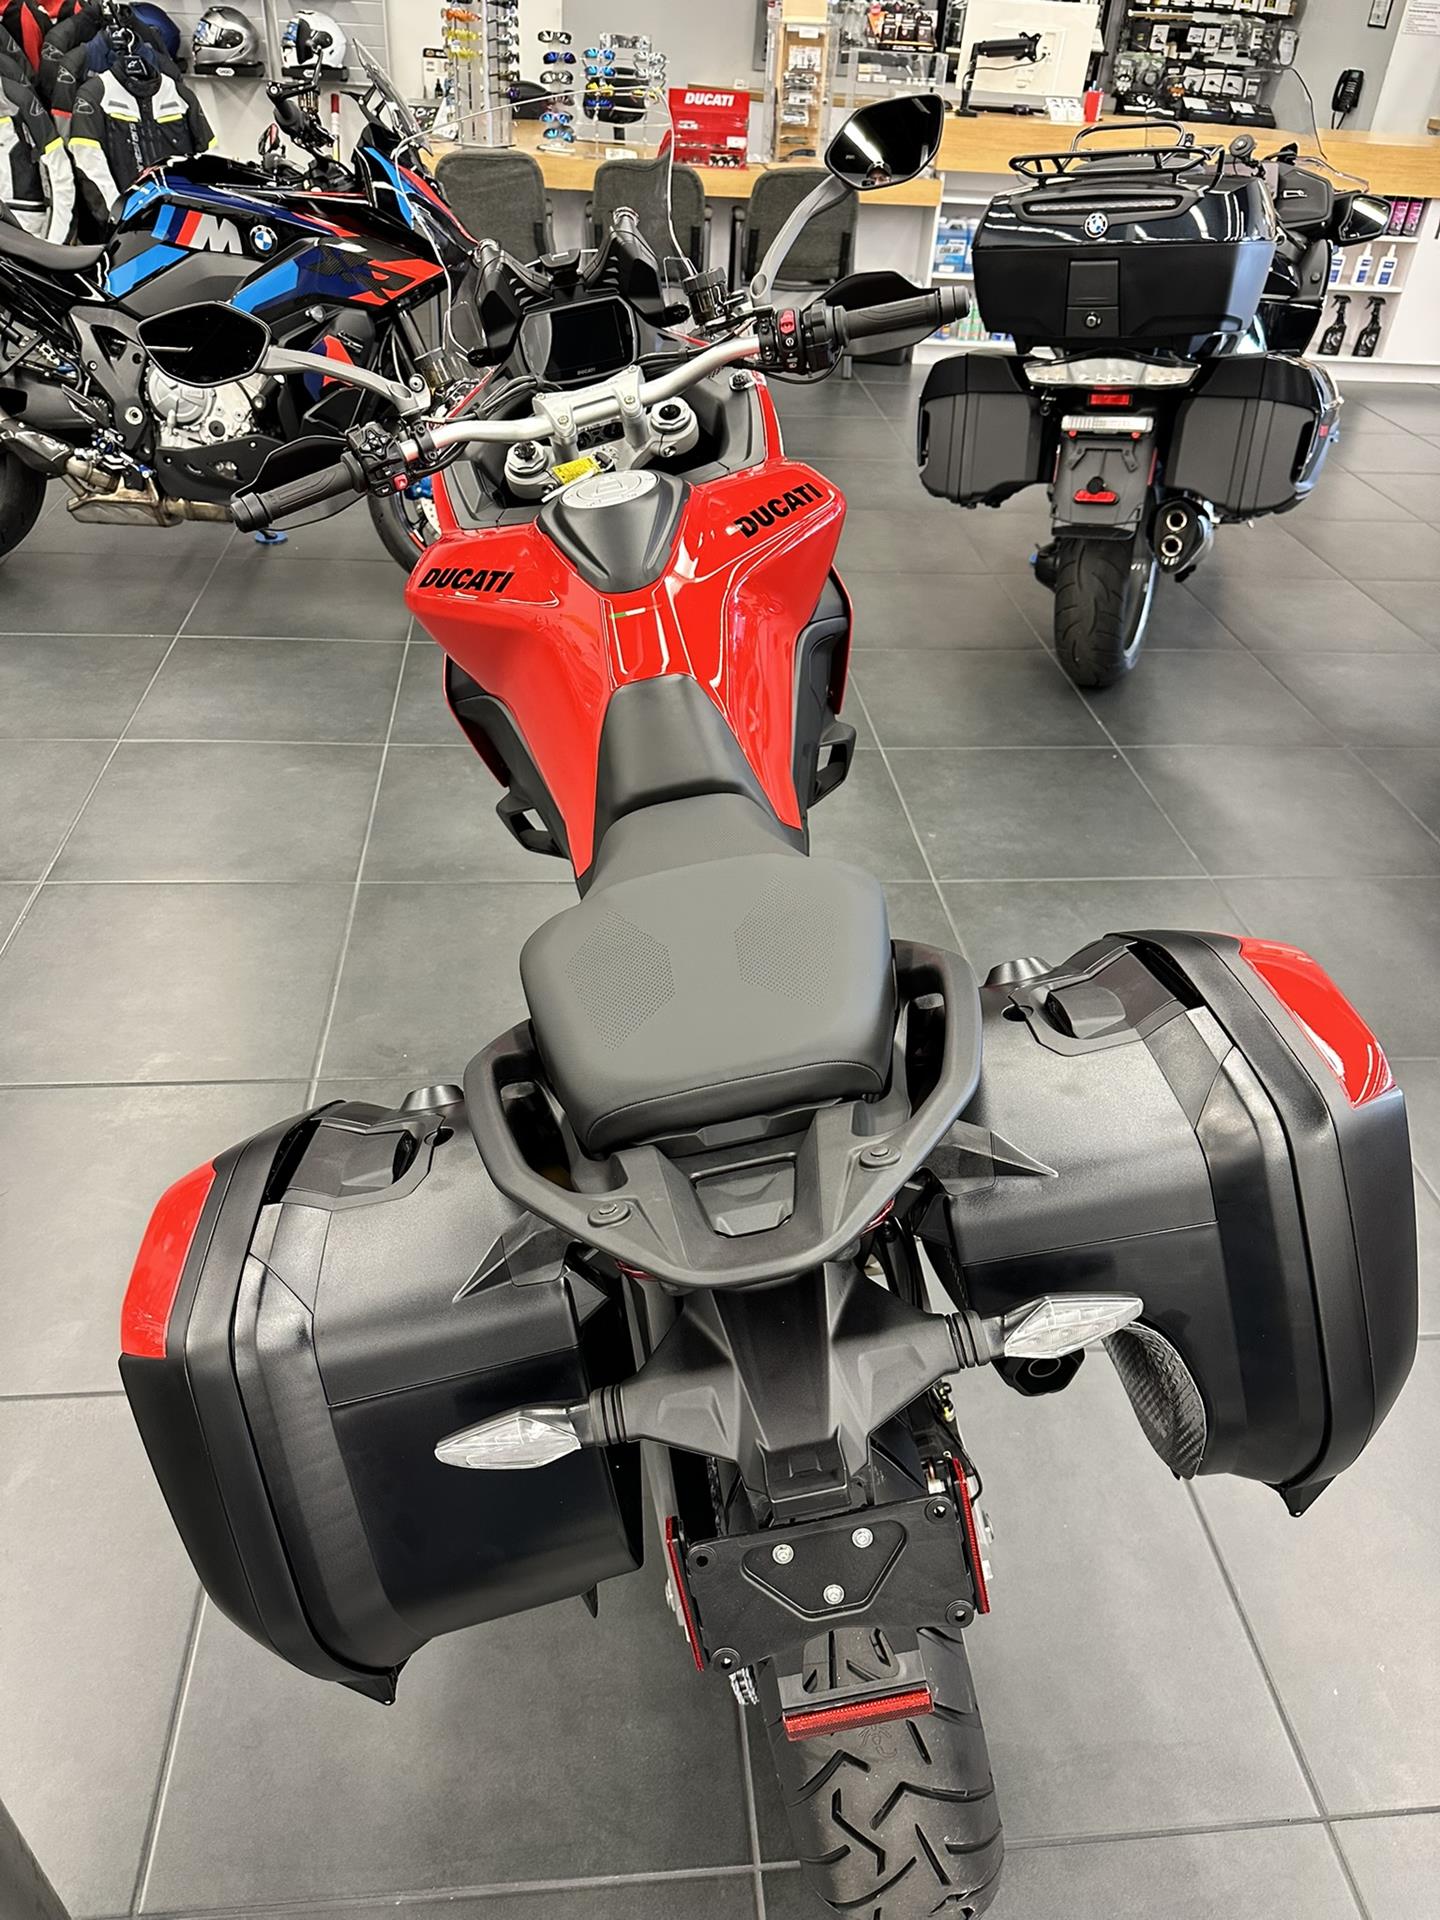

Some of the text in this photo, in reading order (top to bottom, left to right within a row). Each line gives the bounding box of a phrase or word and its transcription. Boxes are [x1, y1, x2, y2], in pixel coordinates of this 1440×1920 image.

[684, 92, 735, 107] DUCATI
[190, 213, 243, 254] M
[733, 483, 823, 538] DUCATI
[418, 567, 515, 593] DUCATI
